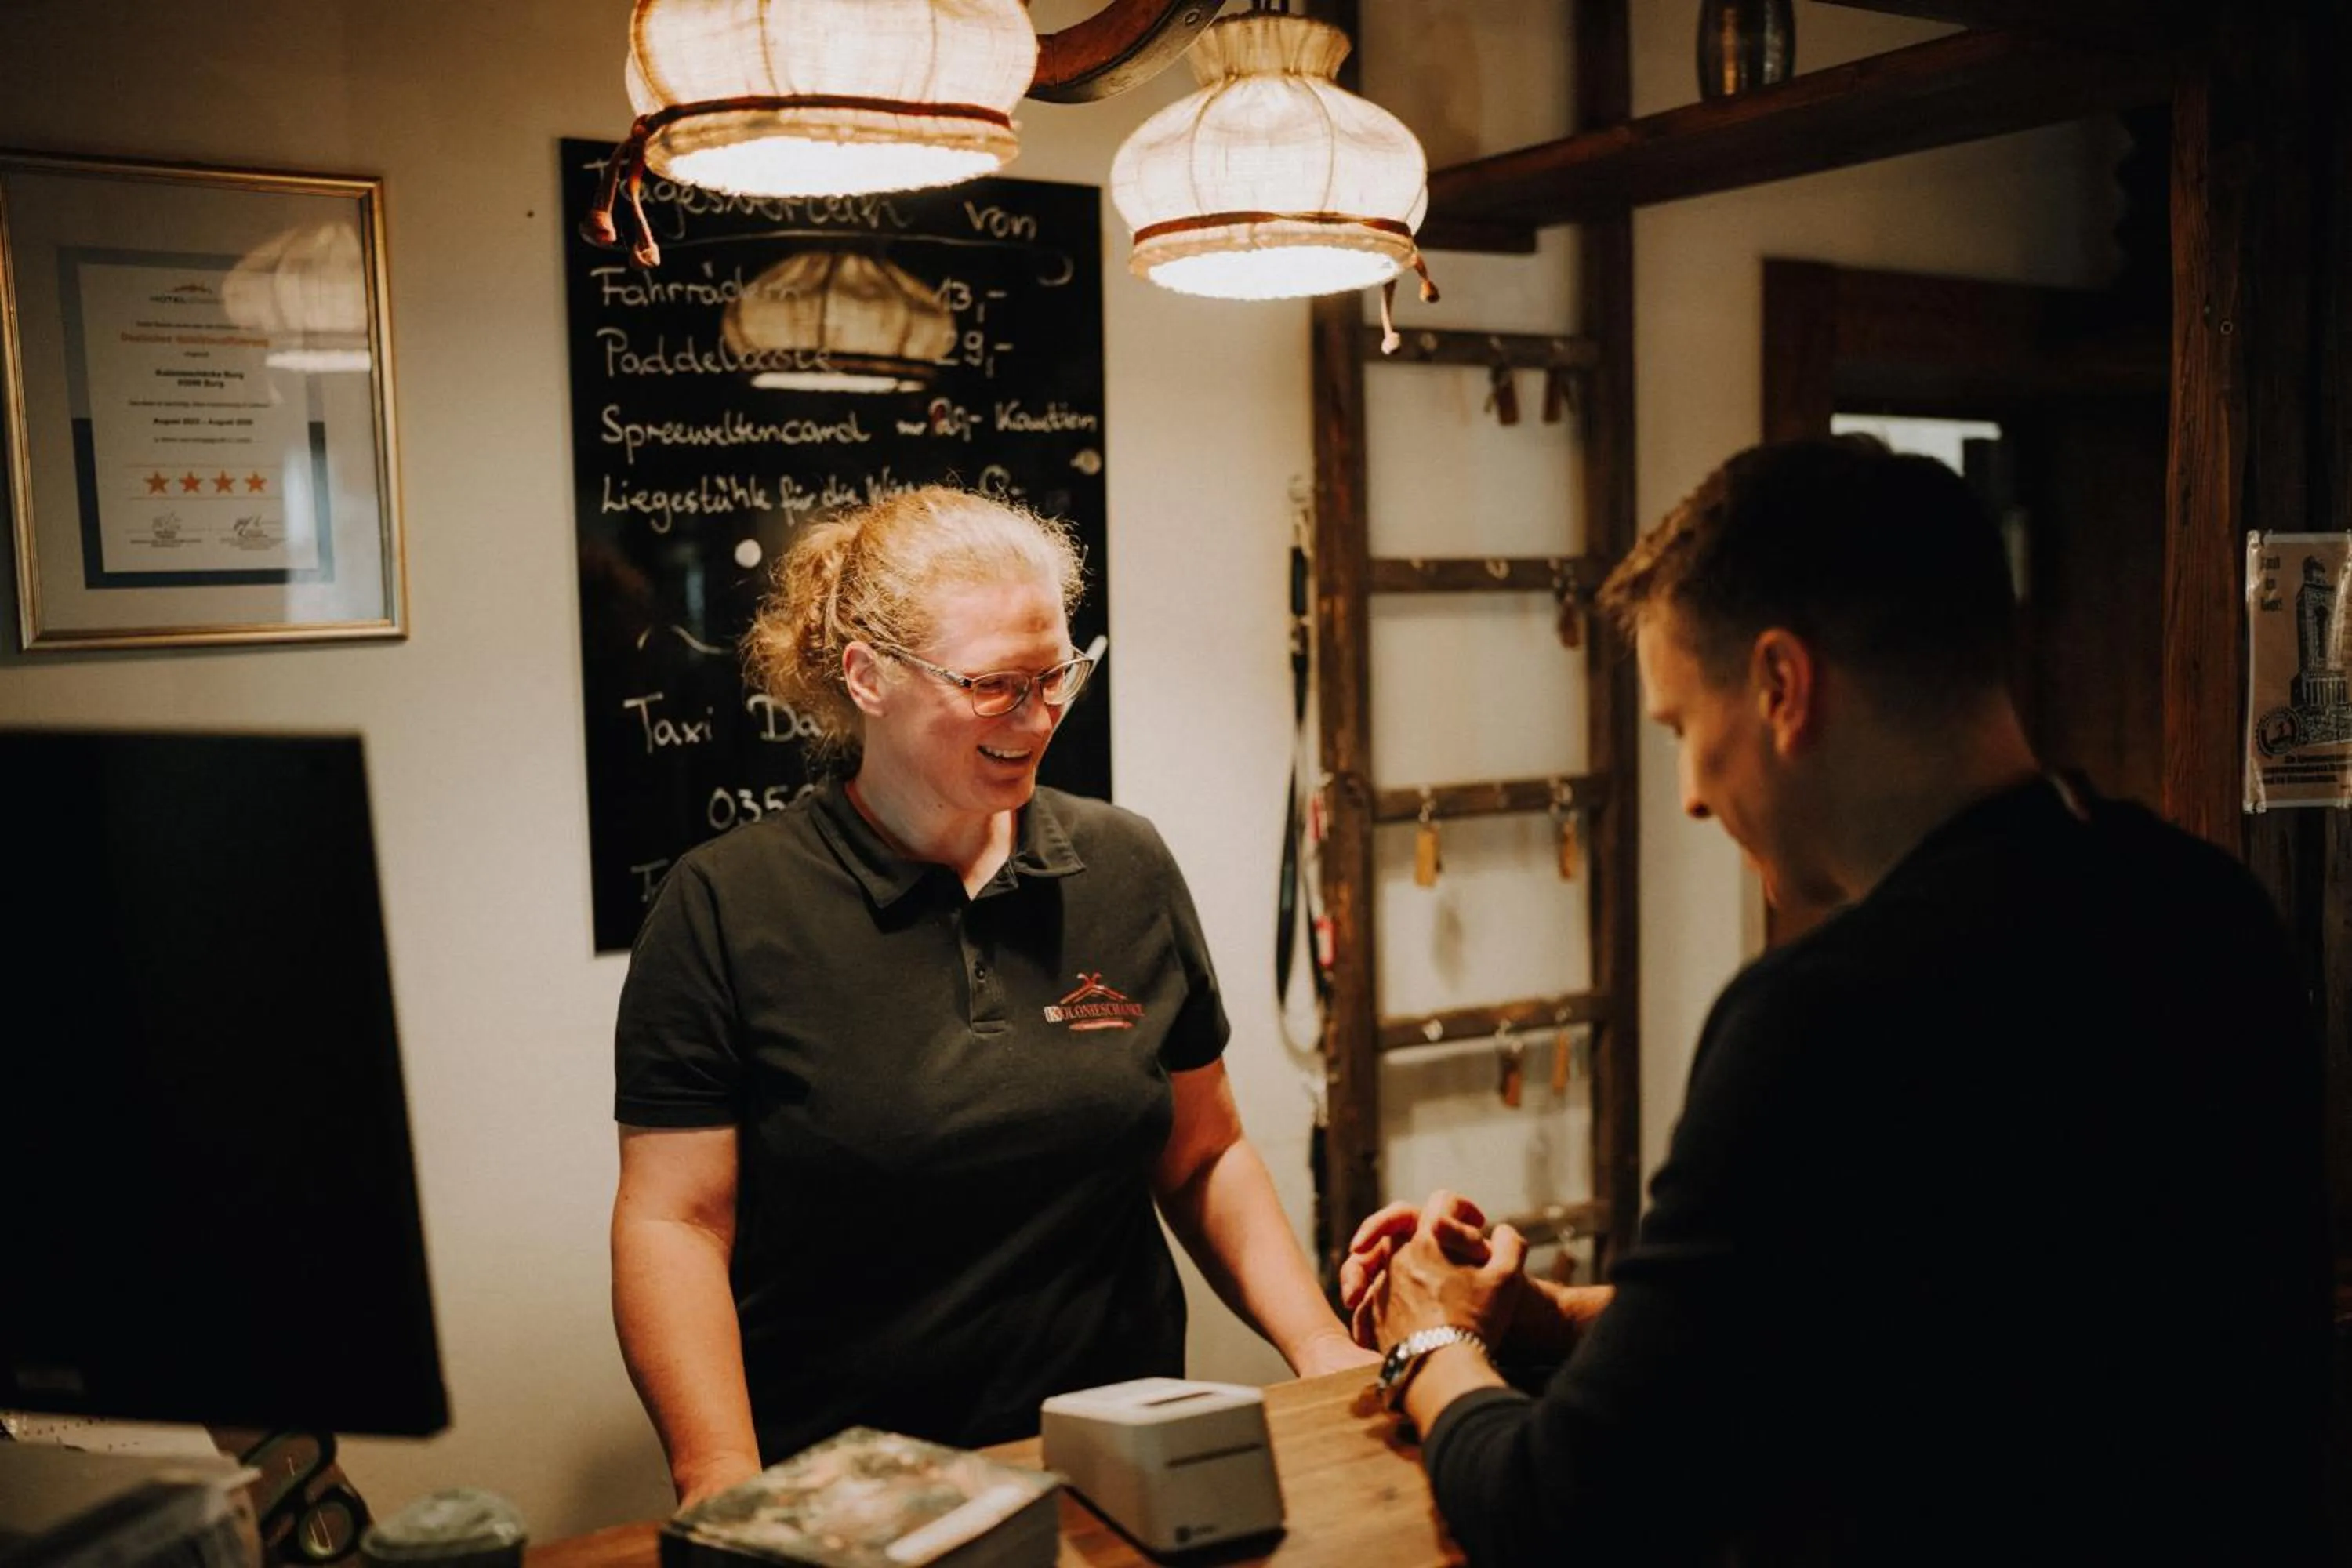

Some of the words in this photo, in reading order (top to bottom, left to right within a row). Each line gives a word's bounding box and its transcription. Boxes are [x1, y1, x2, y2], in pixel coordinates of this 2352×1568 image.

[601, 475, 773, 535] Liegestühle
[623, 691, 714, 754] Taxi
[747, 695, 823, 742] Da
